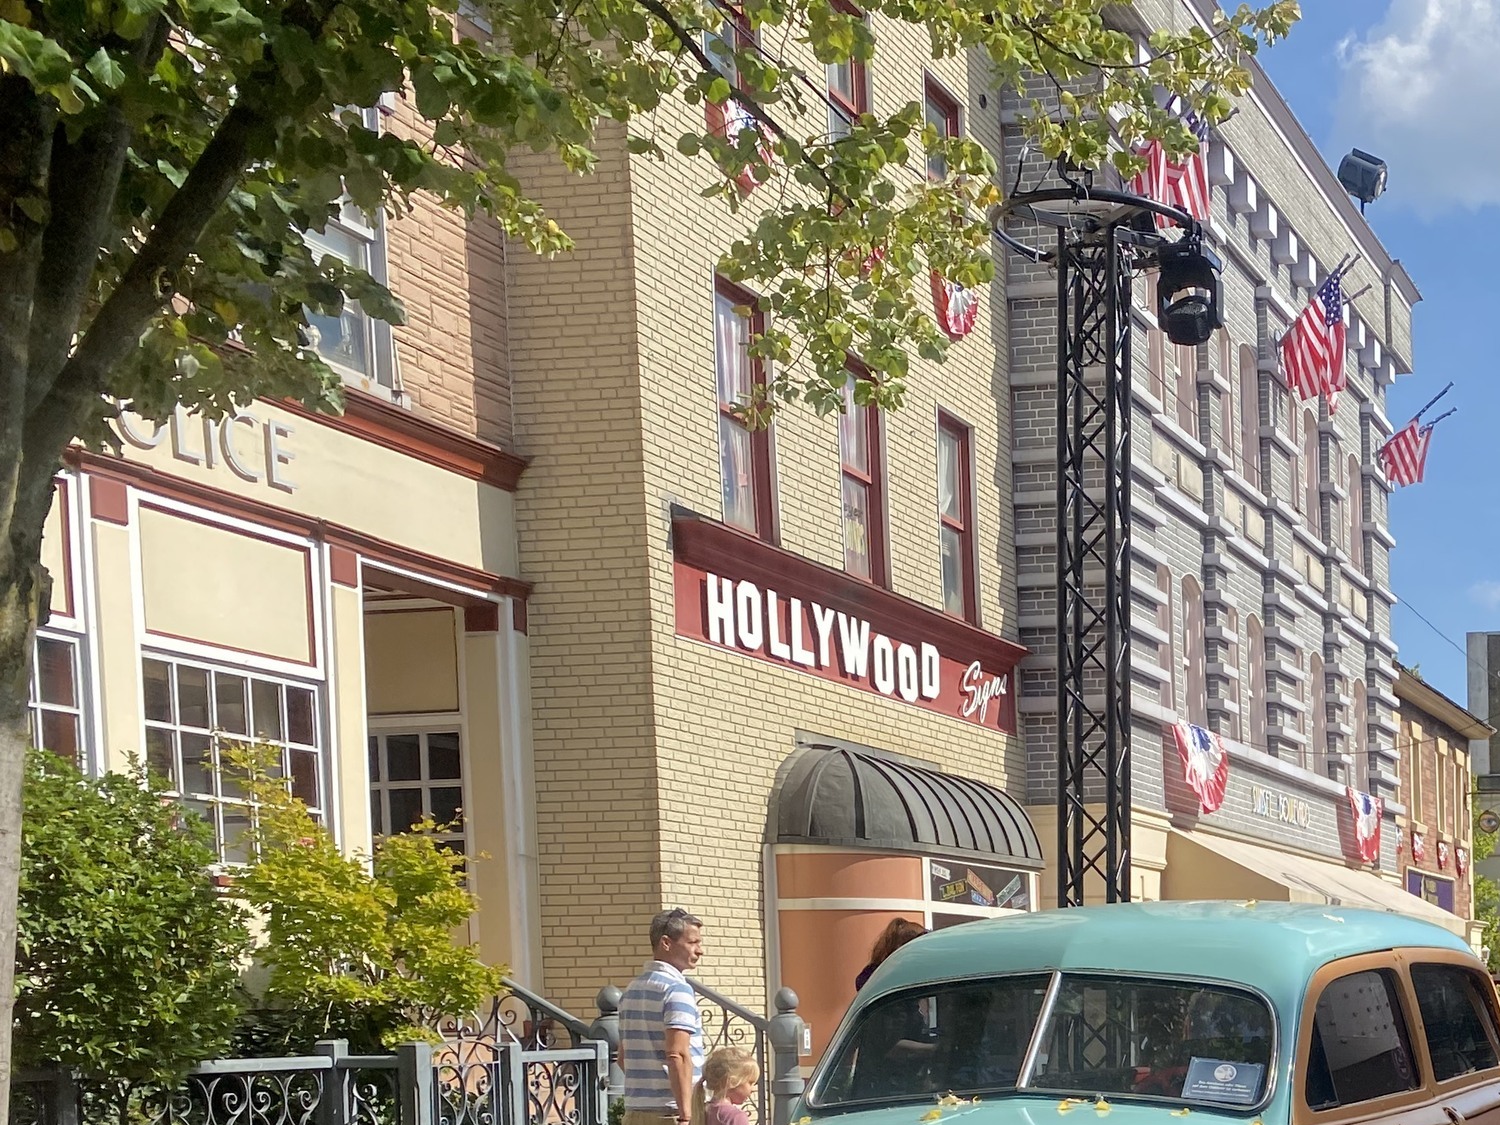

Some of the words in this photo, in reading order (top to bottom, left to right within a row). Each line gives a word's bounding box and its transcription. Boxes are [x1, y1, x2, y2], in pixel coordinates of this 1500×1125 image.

[112, 399, 298, 494] OLICE
[705, 571, 941, 703] HOLLYWOOD
[962, 659, 1008, 724] Signs
